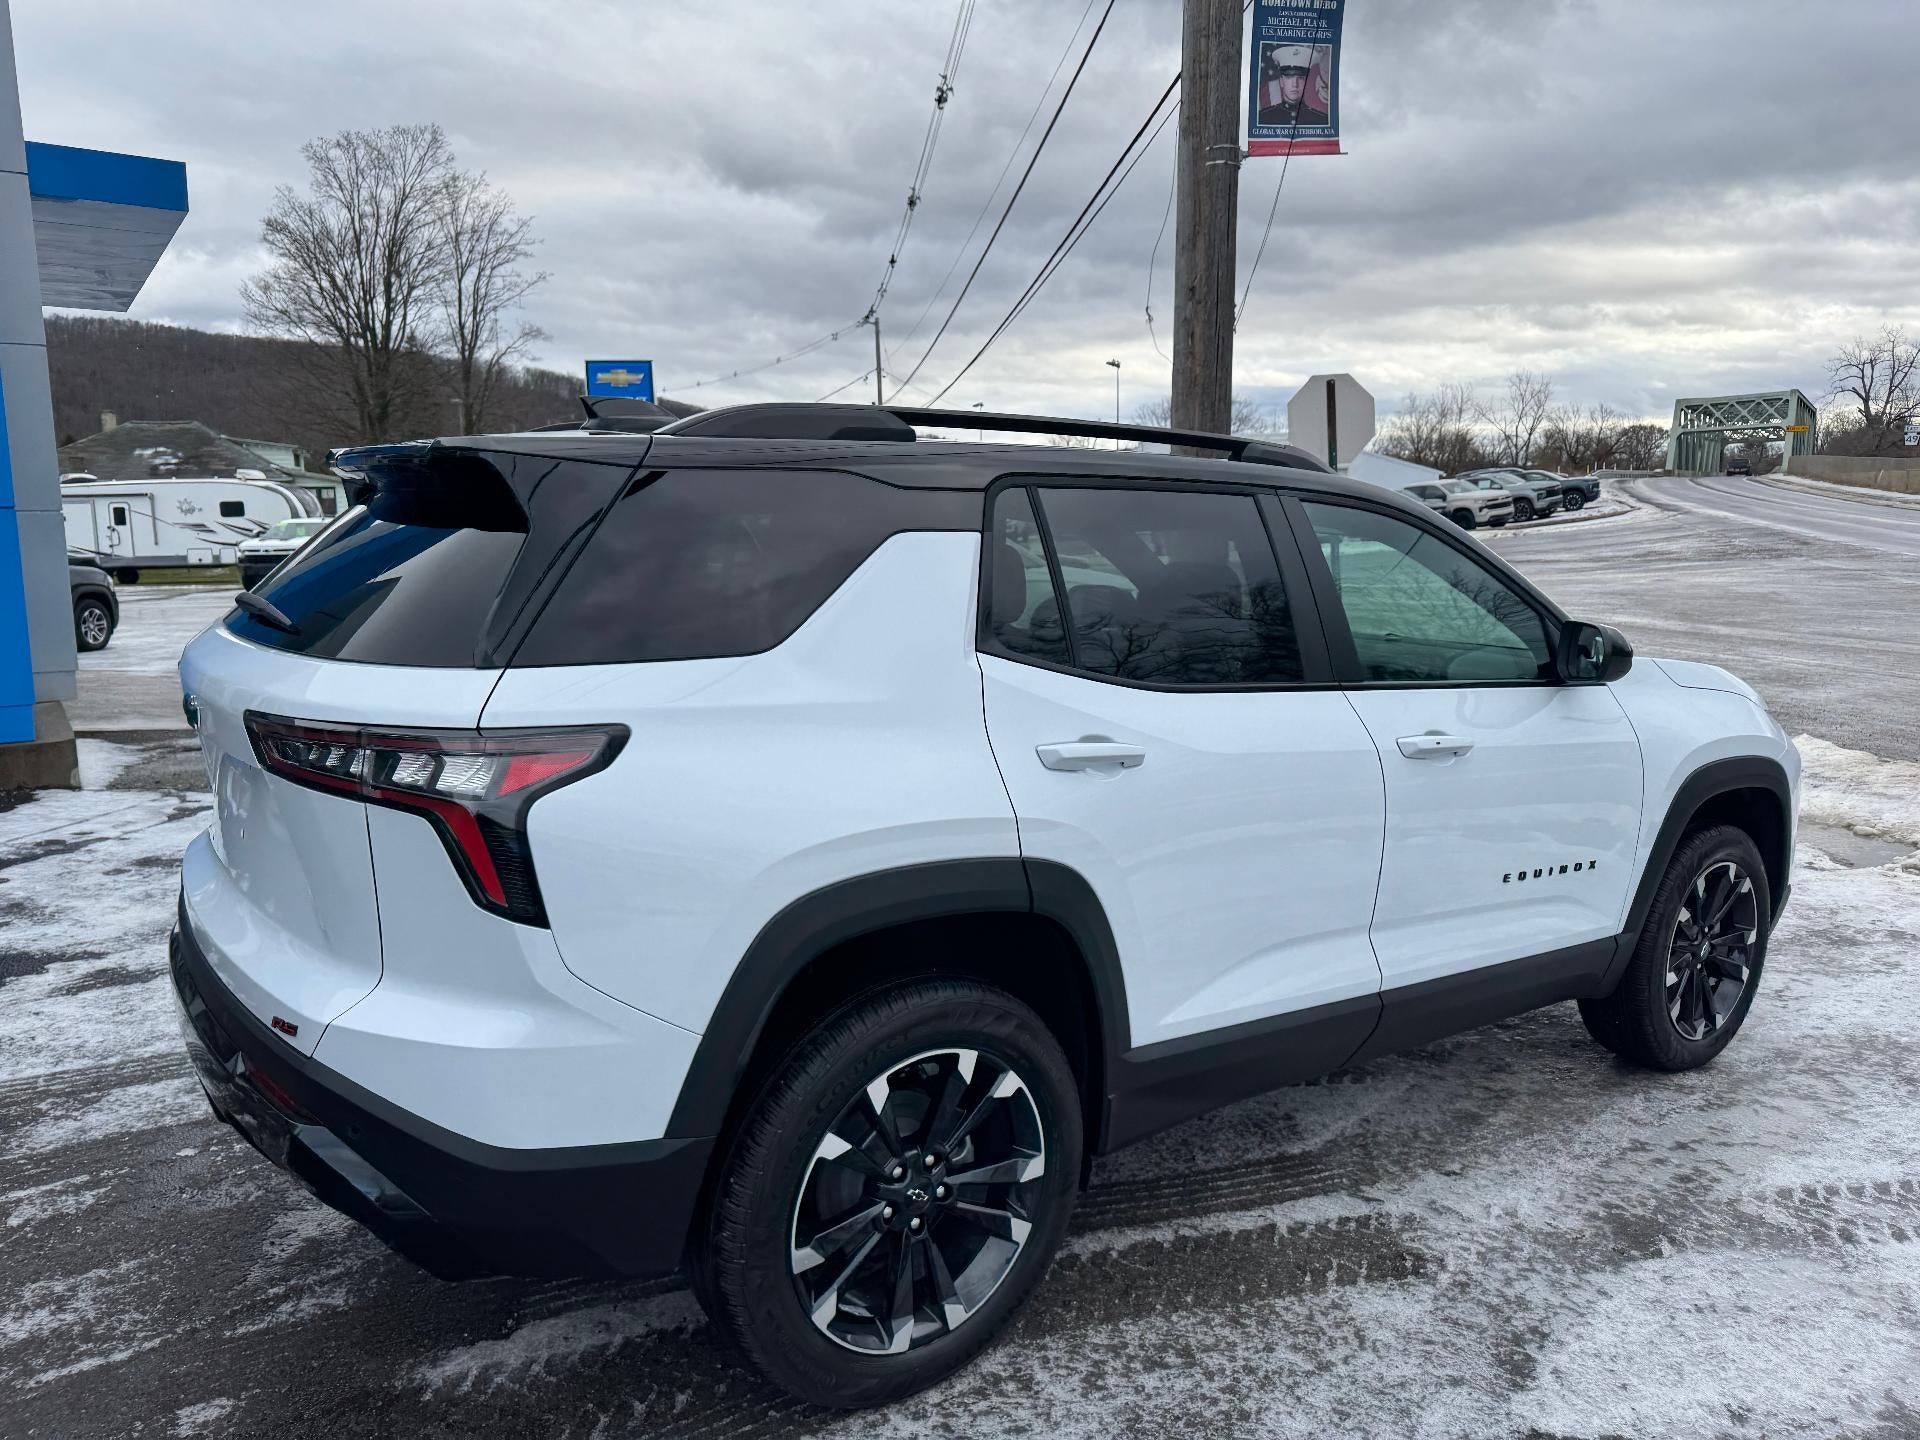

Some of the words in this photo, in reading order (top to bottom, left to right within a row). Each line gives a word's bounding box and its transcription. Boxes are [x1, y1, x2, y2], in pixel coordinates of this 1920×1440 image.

[1313, 0, 1337, 10] HERO
[1268, 17, 1302, 26] MICHAEL
[1277, 28, 1307, 38] MARINE
[1905, 435, 1918, 443] 49
[1502, 860, 1596, 883] EQUINOX
[271, 1015, 299, 1037] RS
